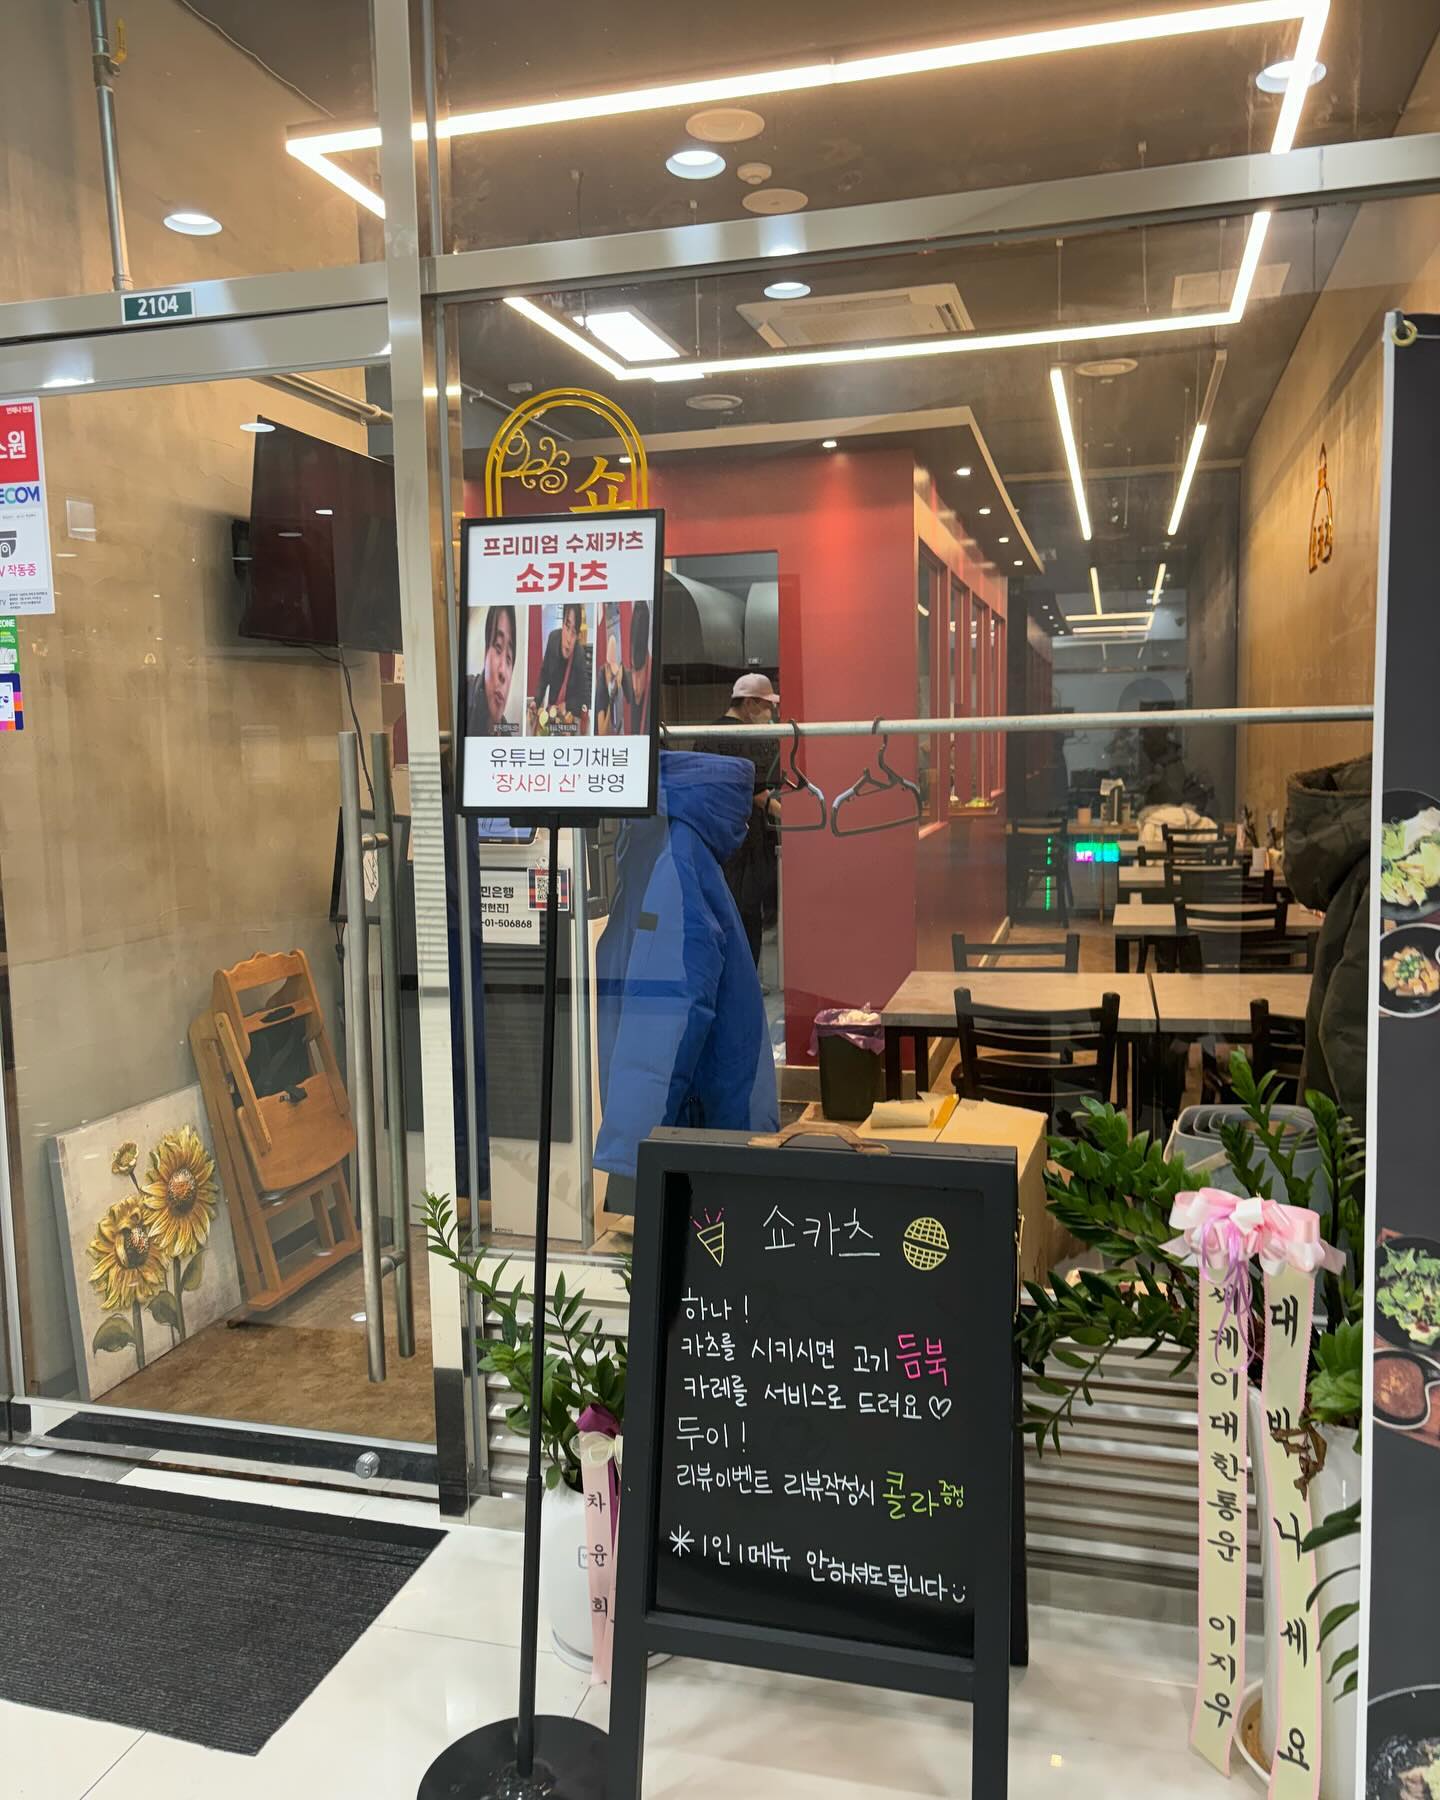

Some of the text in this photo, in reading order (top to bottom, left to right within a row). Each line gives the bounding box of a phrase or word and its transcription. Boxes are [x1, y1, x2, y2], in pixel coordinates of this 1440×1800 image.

[138, 295, 179, 316] 2104
[483, 531, 643, 556] 프리미엄 수제카츠
[7, 563, 37, 577] 작동중
[515, 560, 608, 593] 쇼카츠
[490, 747, 628, 768] 유튜브 인기채널
[588, 773, 625, 793] 방영
[763, 1205, 880, 1257] 쇼카츠
[681, 1331, 735, 1361] 카츠를
[751, 1337, 834, 1369] 시키시면
[854, 1346, 888, 1372] 고기
[684, 1374, 922, 1419] 카레를 서비스로 드려요
[677, 1462, 773, 1494] 리뷰이벤트
[784, 1470, 874, 1506] 리뷰작성시
